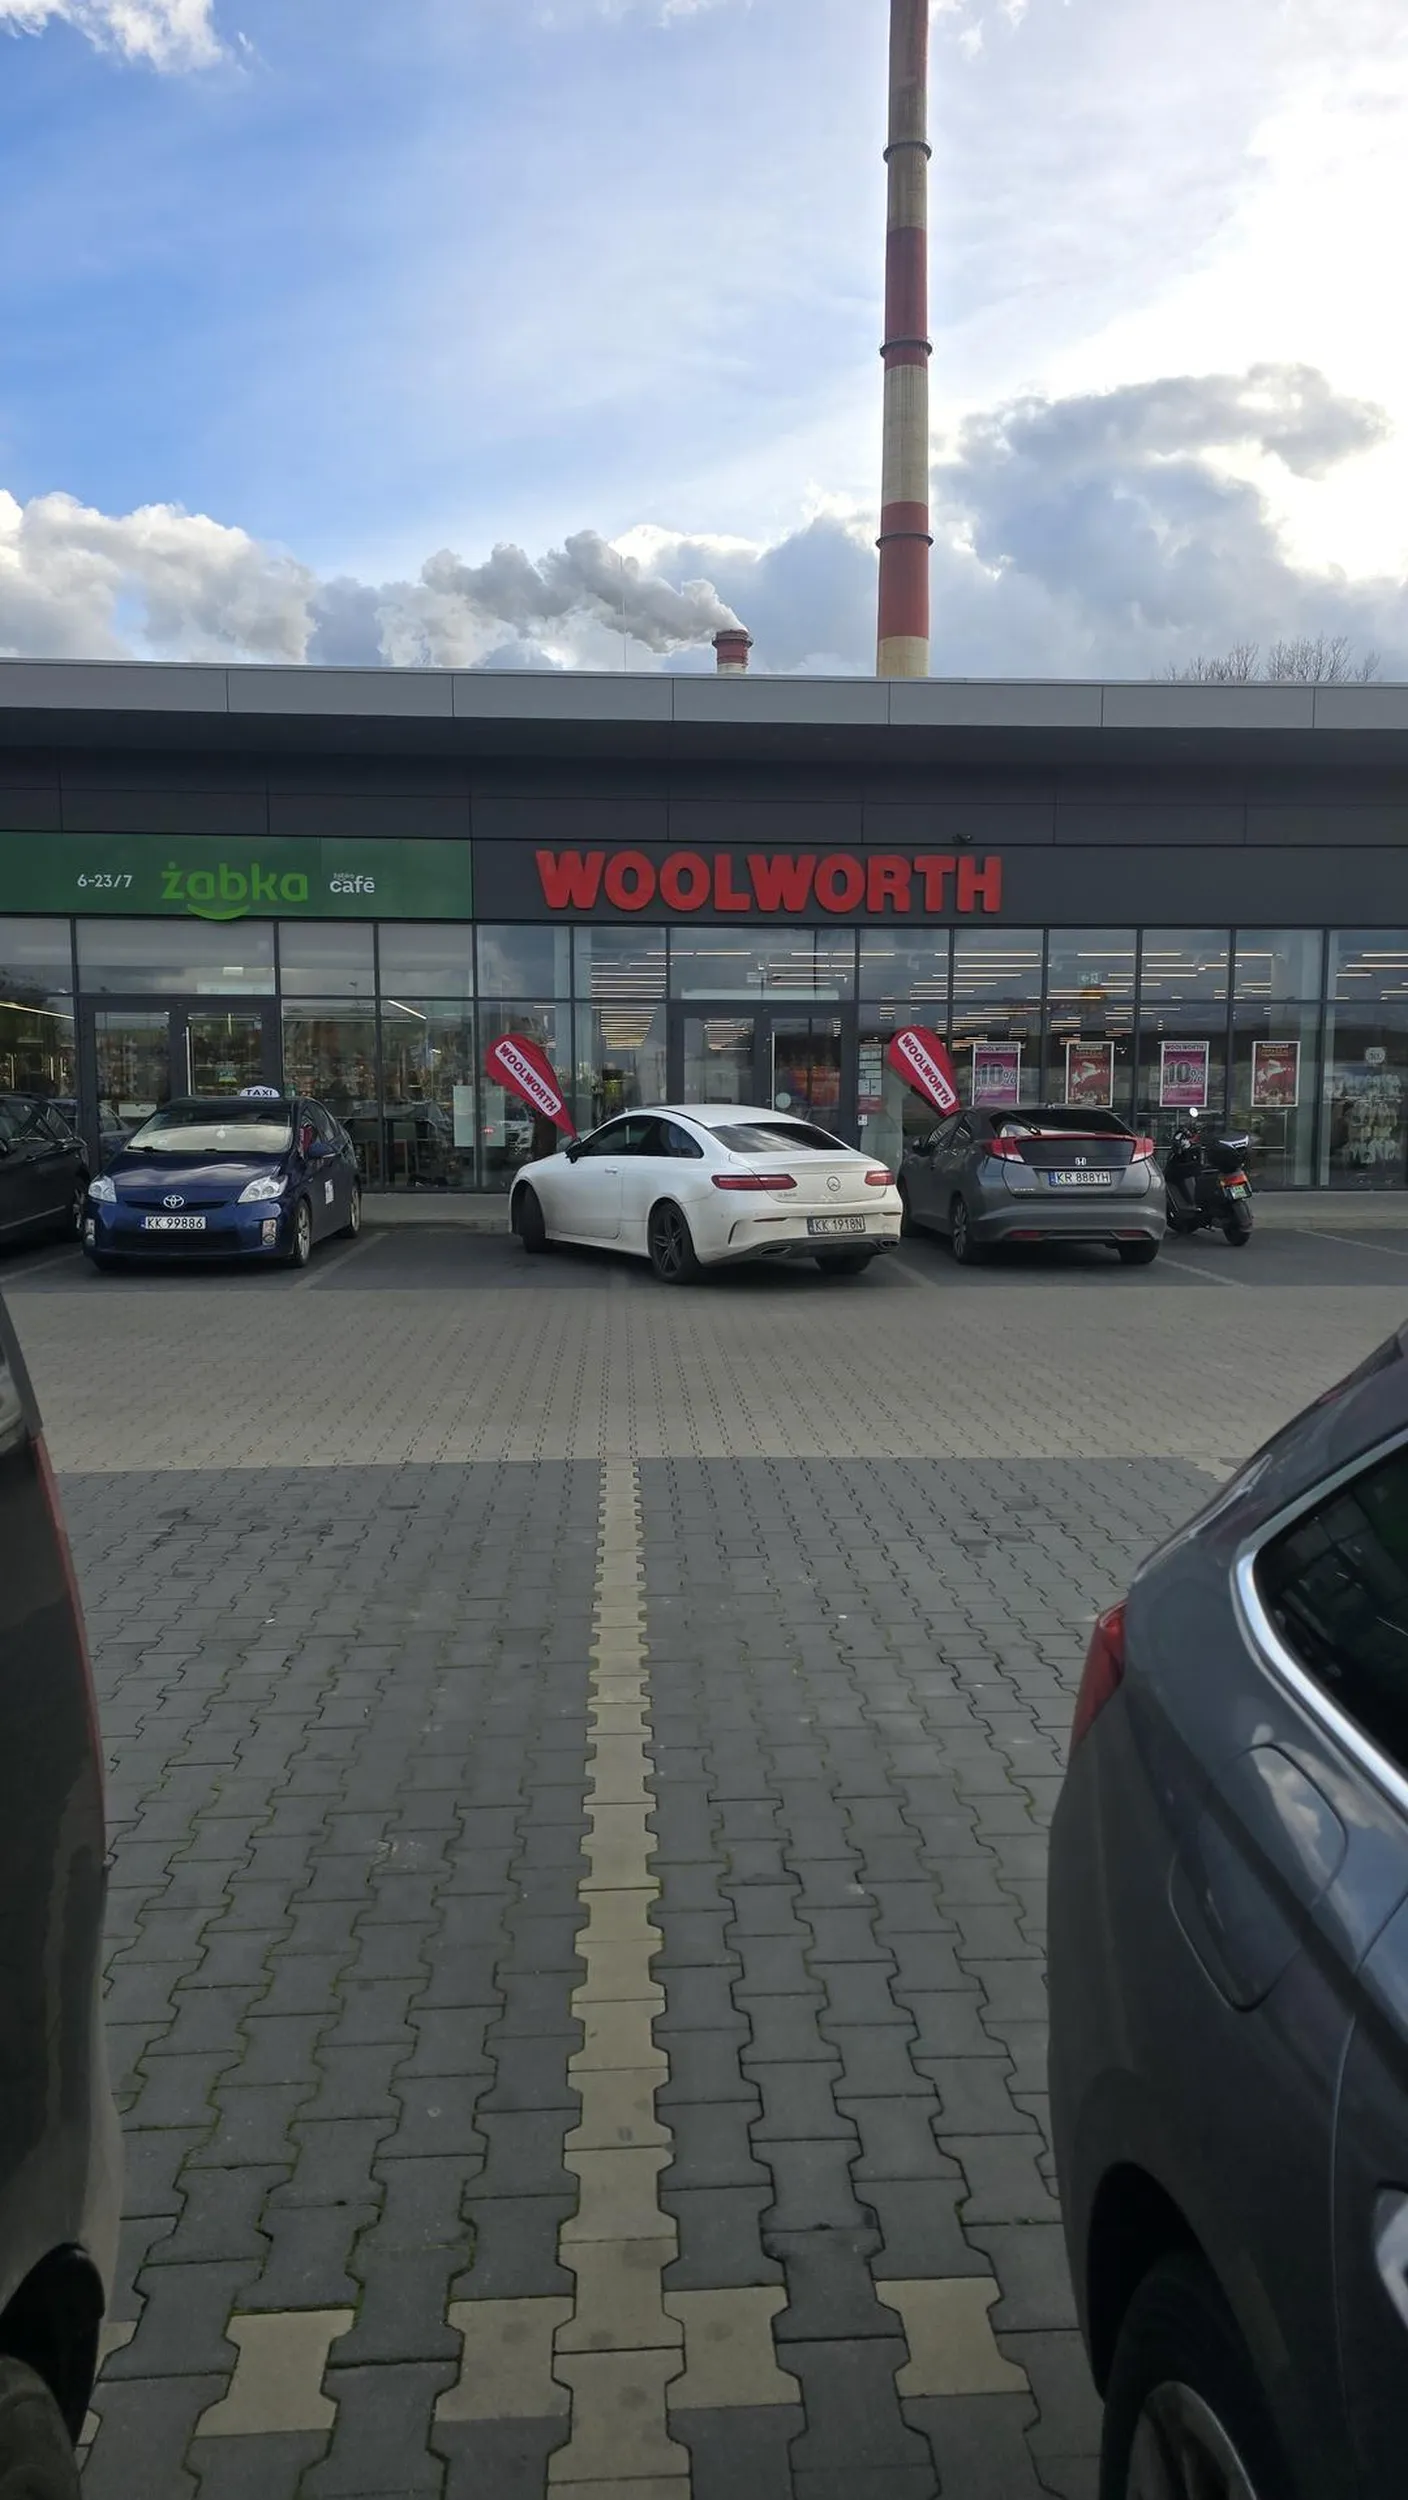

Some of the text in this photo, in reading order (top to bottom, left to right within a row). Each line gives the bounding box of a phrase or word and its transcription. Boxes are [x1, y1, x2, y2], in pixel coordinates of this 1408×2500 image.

[77, 874, 133, 888] 6-23/7
[161, 862, 309, 902] żabka
[535, 850, 1001, 913] WOOLWORTH
[500, 1044, 557, 1112] WOOLWORTH
[902, 1035, 952, 1105] WOOLWORTH
[1057, 1172, 1109, 1182] KR 888YH
[148, 1217, 203, 1229] KK 99886
[815, 1219, 828, 1231] KK
